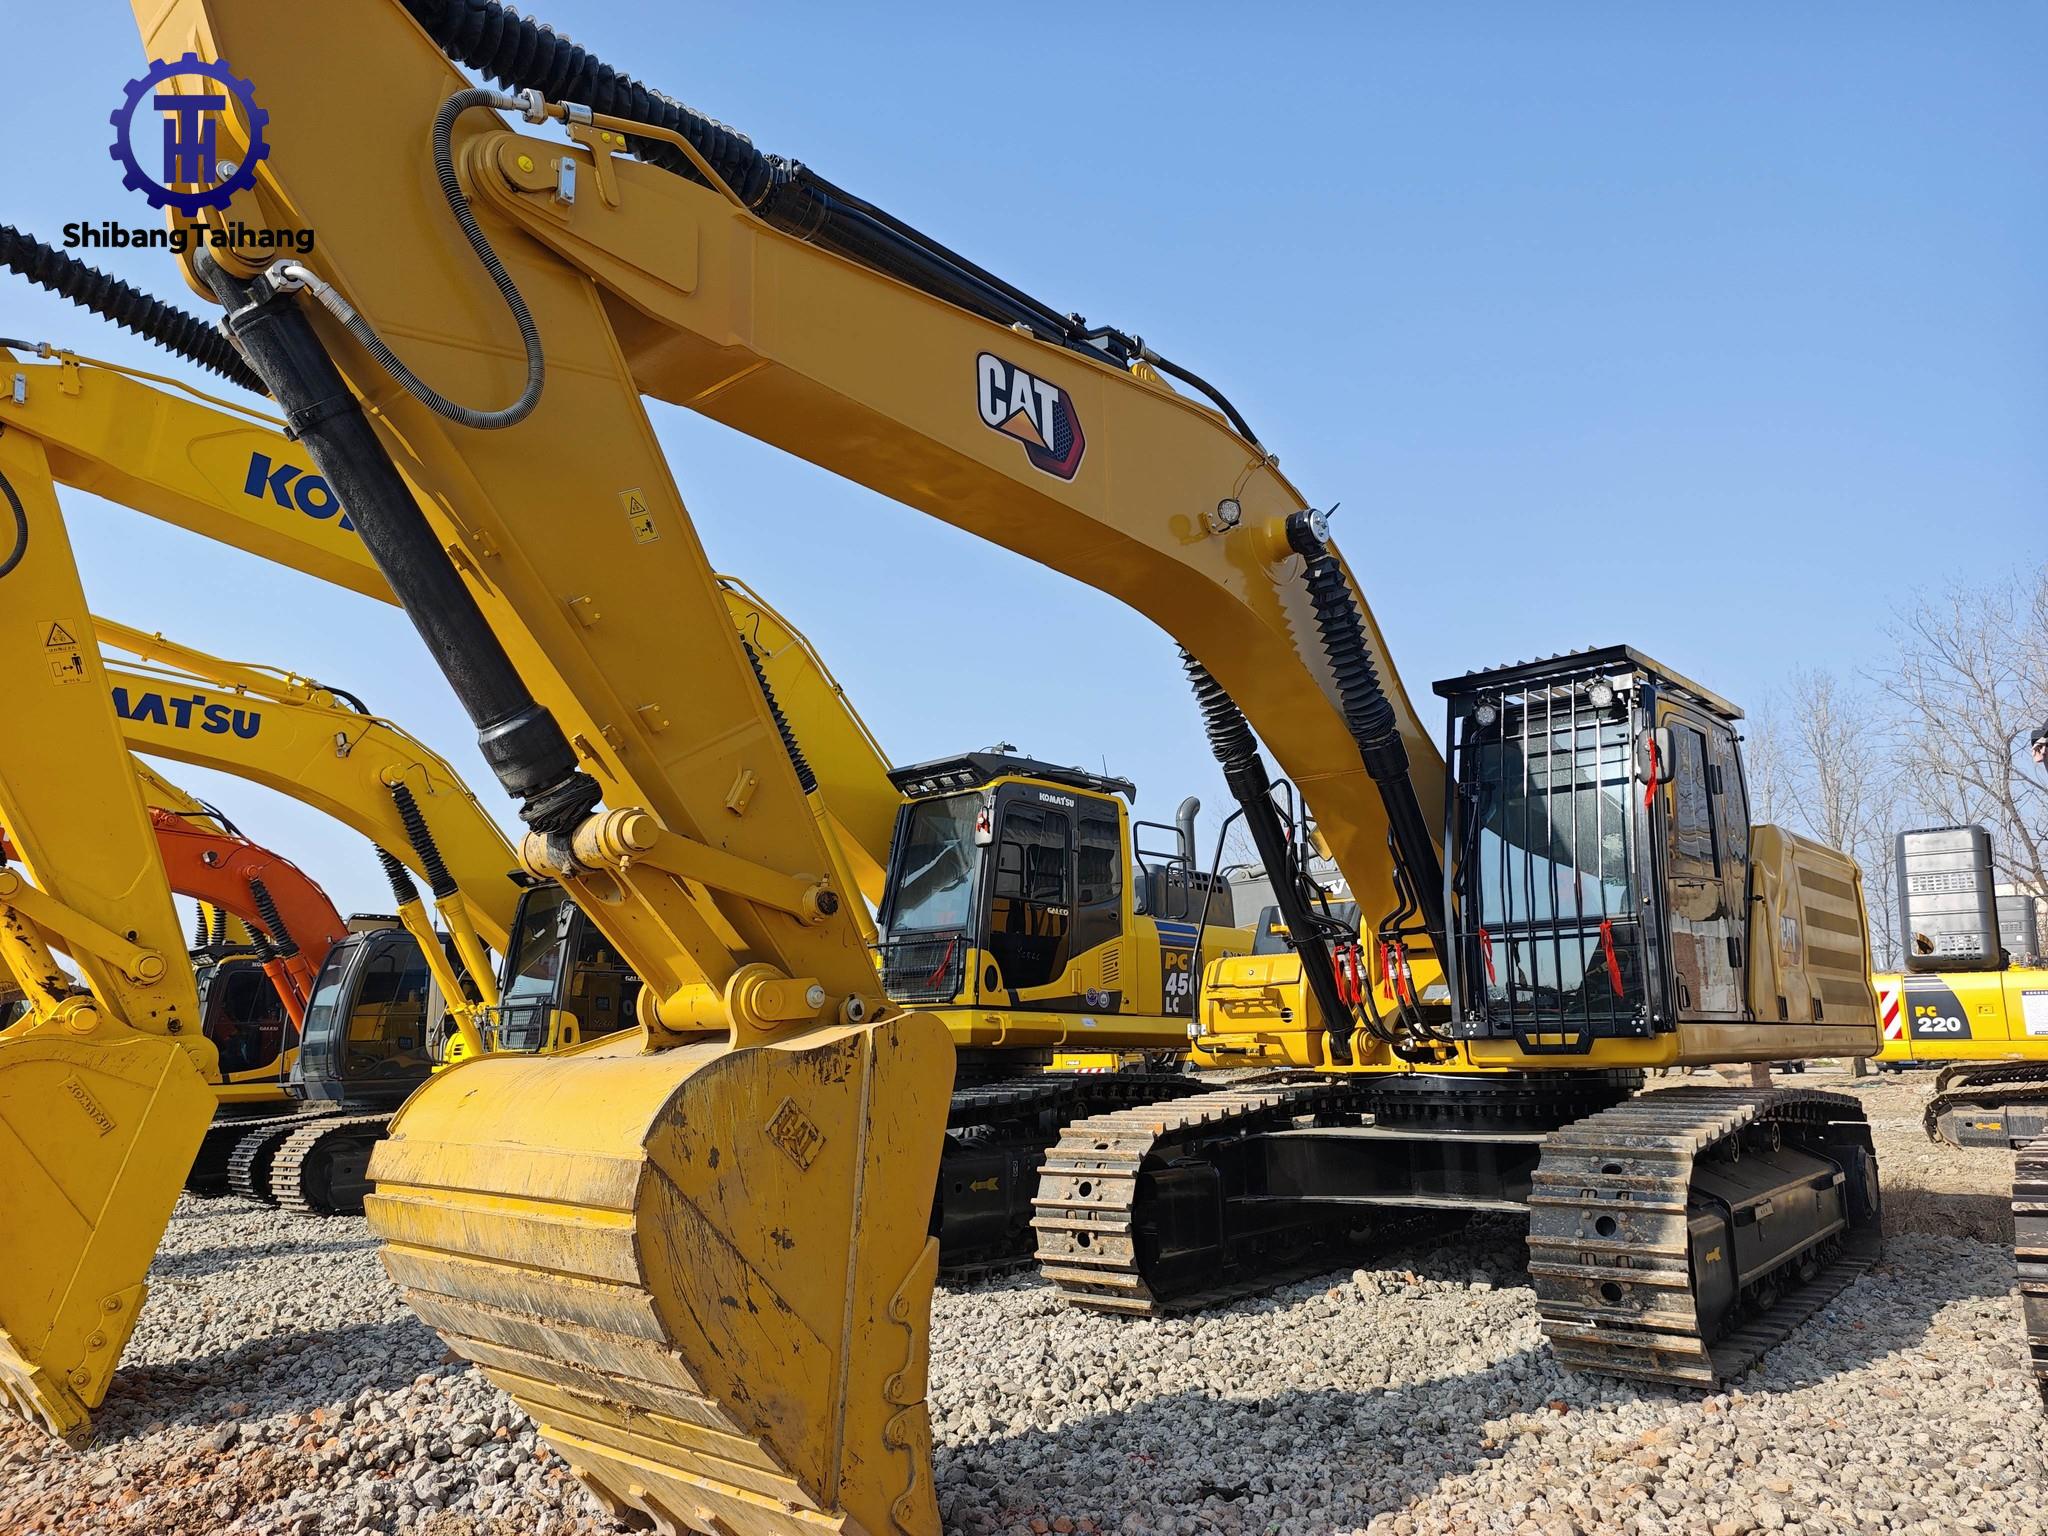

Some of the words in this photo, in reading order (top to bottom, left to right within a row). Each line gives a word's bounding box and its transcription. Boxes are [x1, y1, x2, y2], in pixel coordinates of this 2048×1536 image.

[978, 354, 1059, 452] CAT
[244, 451, 355, 532] KO
[1039, 791, 1075, 808] KOMATSU
[1780, 916, 1797, 952] CAT
[1165, 951, 1188, 970] PC
[1165, 996, 1179, 1013] LC
[1915, 1006, 1937, 1017] PC
[1918, 1017, 1961, 1032] 220
[66, 1081, 112, 1131] KOMATSU
